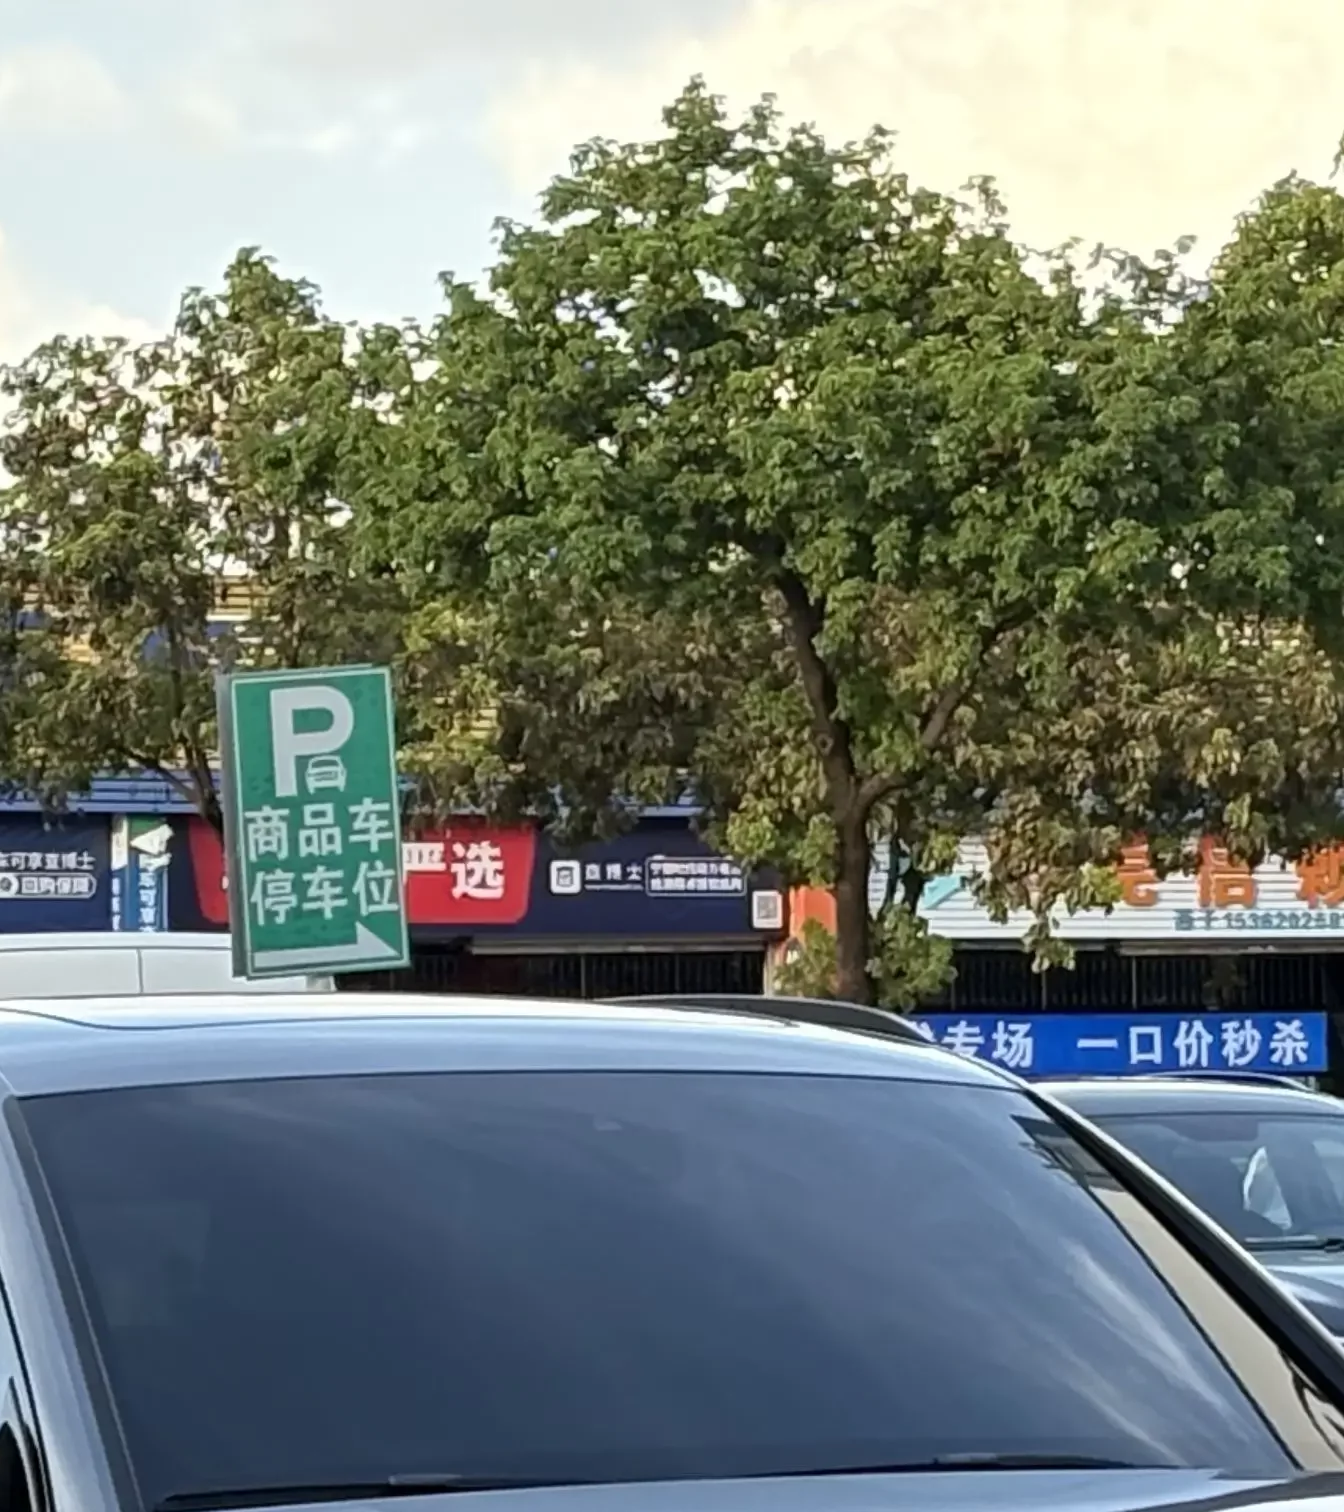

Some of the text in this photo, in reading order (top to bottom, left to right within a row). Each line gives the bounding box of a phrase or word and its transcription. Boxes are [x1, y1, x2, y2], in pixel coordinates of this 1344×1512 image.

[270, 685, 354, 797] P
[244, 797, 394, 863] 商品车
[250, 860, 400, 926] 停车位
[1076, 1019, 1309, 1068] 一口价秒杀
